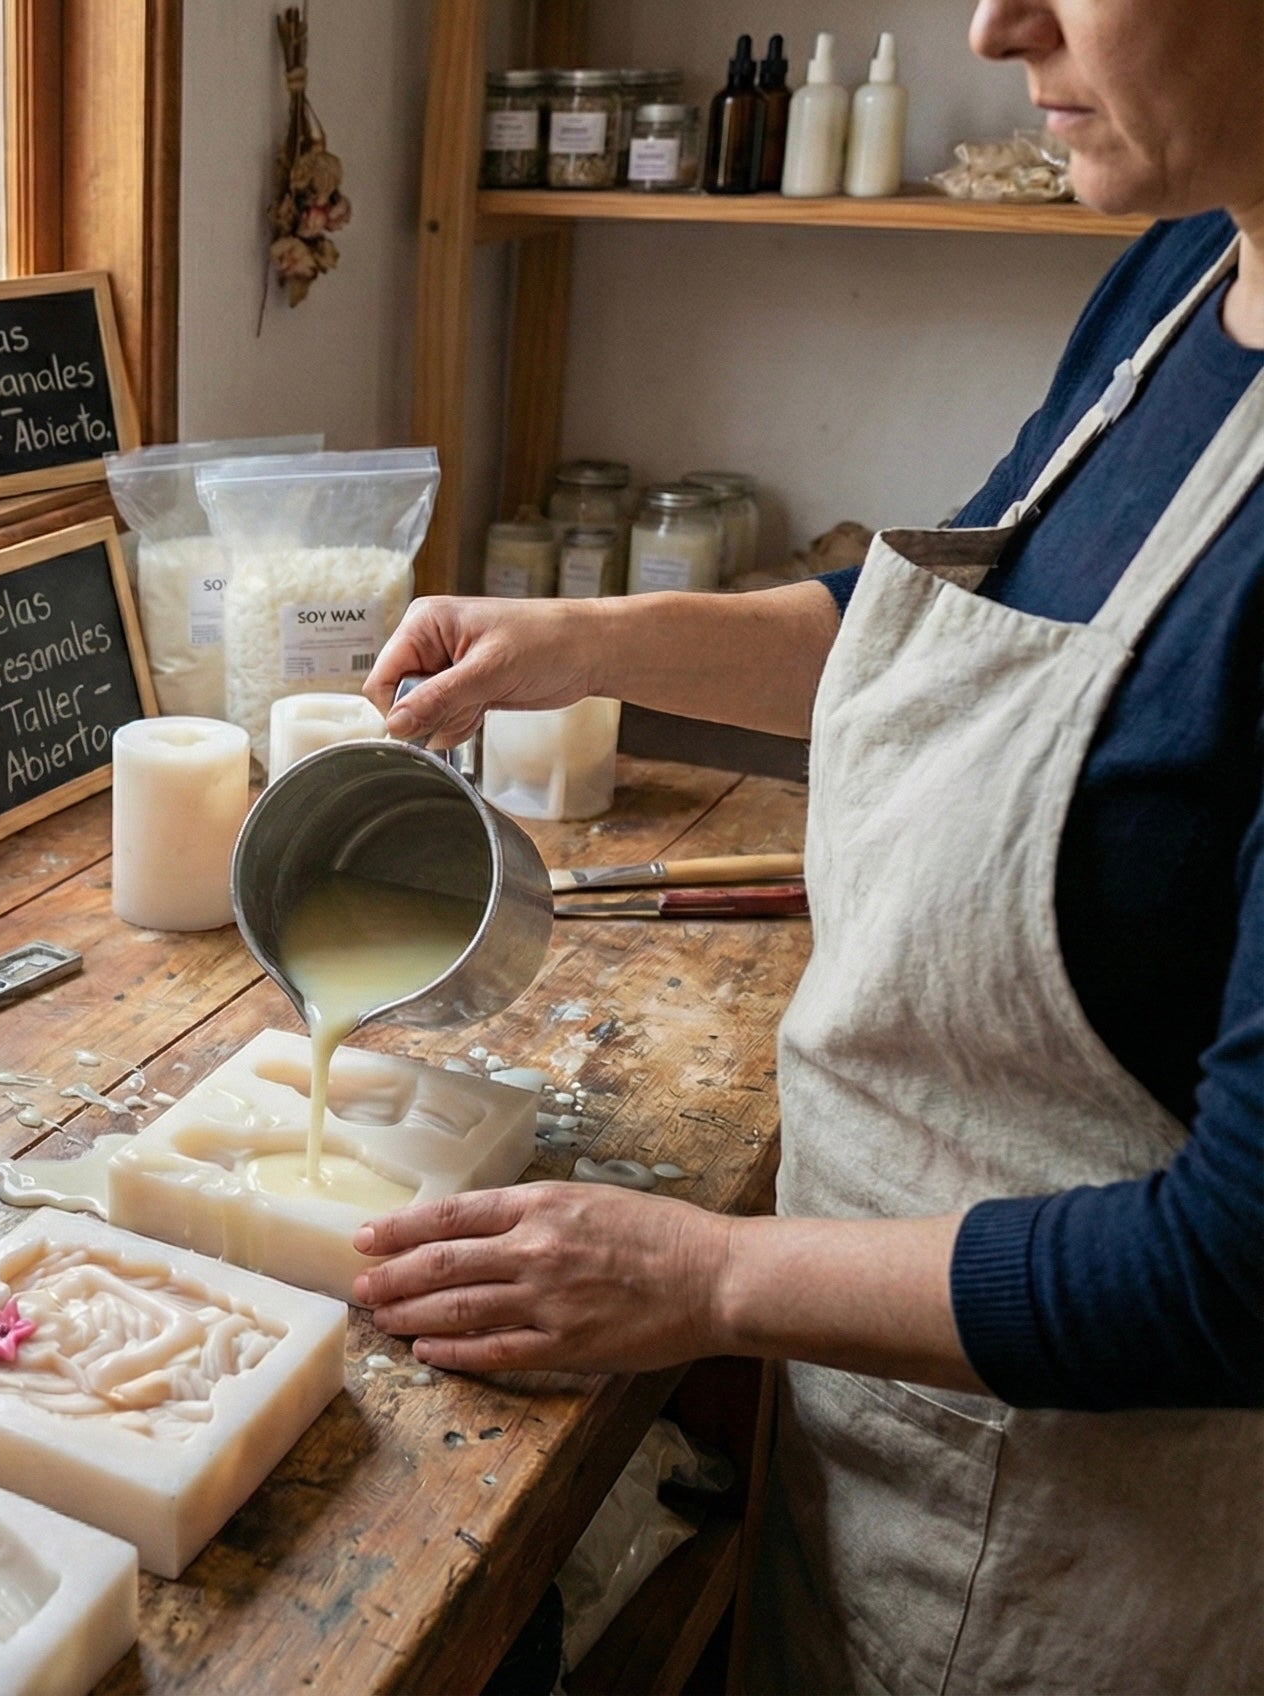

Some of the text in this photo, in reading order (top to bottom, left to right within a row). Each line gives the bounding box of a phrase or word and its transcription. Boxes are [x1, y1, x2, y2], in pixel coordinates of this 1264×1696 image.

[14, 403, 112, 454] Abierto.
[297, 608, 367, 624] SOY WAX
[0, 684, 84, 737] Taller
